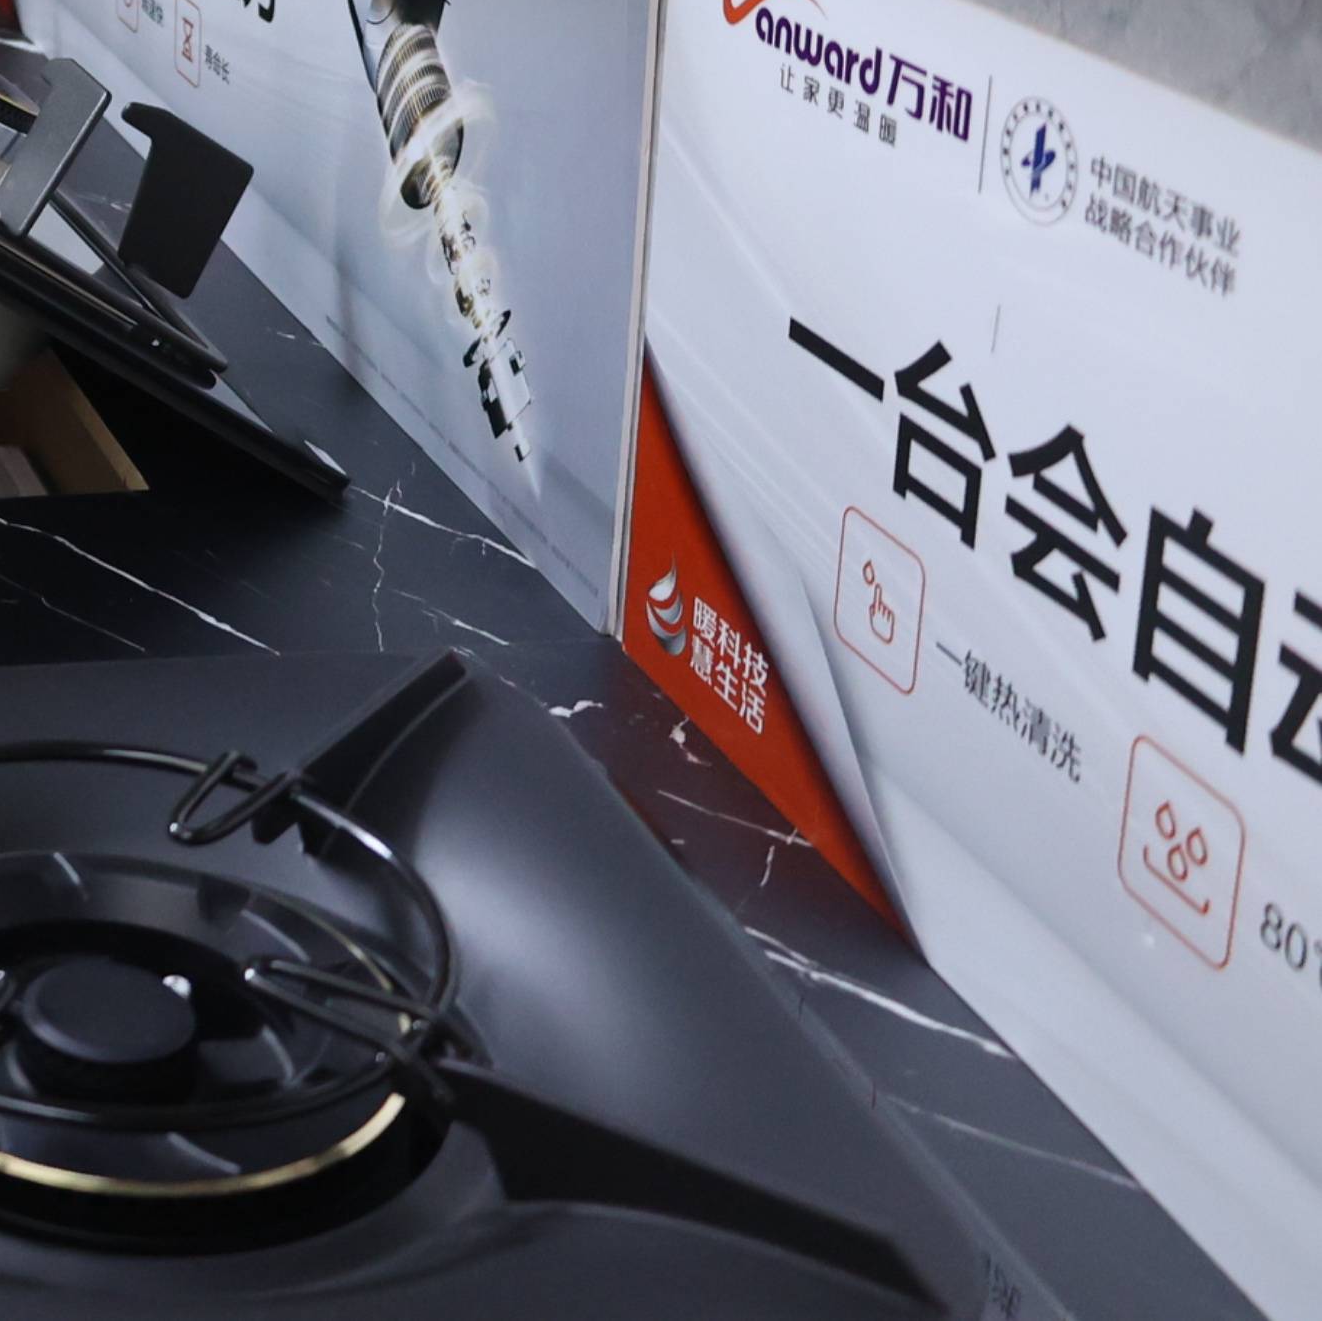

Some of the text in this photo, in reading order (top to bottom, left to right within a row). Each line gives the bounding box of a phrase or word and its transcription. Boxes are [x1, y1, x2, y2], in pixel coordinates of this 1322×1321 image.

[780, 62, 897, 147] 让家更温暖
[1084, 192, 1236, 298] 战略合作伙伴
[1090, 155, 1241, 257] 中国航天事业
[689, 633, 764, 735] 慧生活
[692, 595, 770, 698] 暖科技
[935, 640, 1081, 784] 一键热清洗
